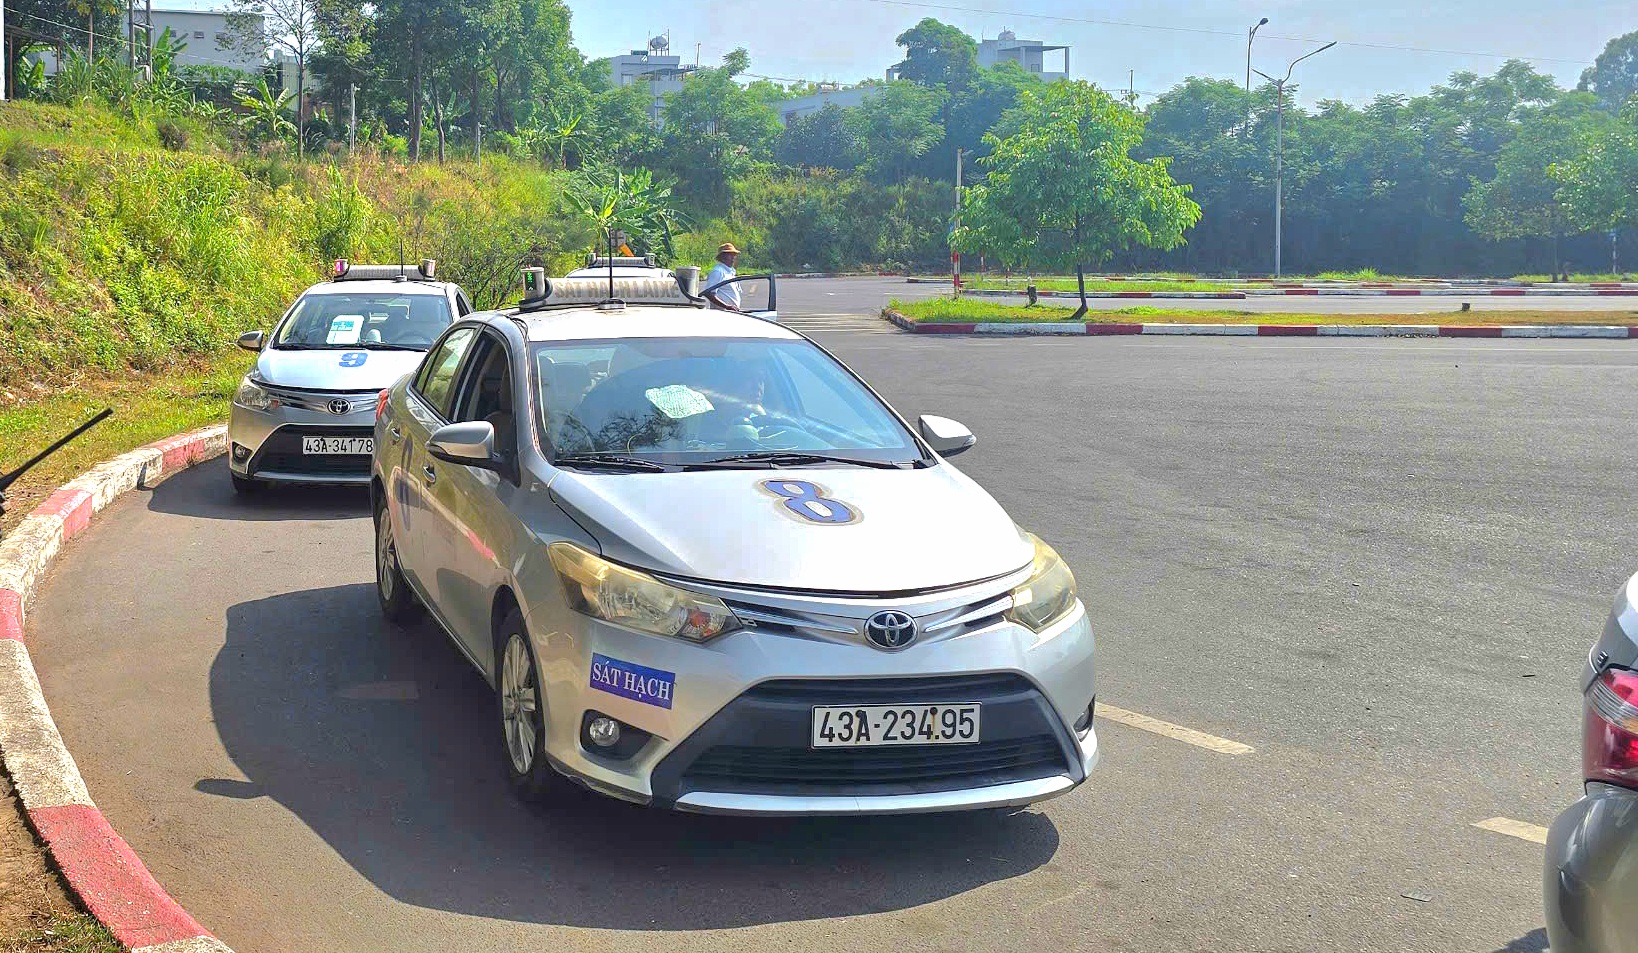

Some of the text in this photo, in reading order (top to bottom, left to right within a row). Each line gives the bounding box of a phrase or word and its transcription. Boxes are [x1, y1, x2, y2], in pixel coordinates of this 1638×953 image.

[339, 353, 368, 367] 9
[760, 479, 856, 524] 8
[592, 660, 671, 700] SÁT HẠCH
[820, 708, 975, 743] 43A-234.95
